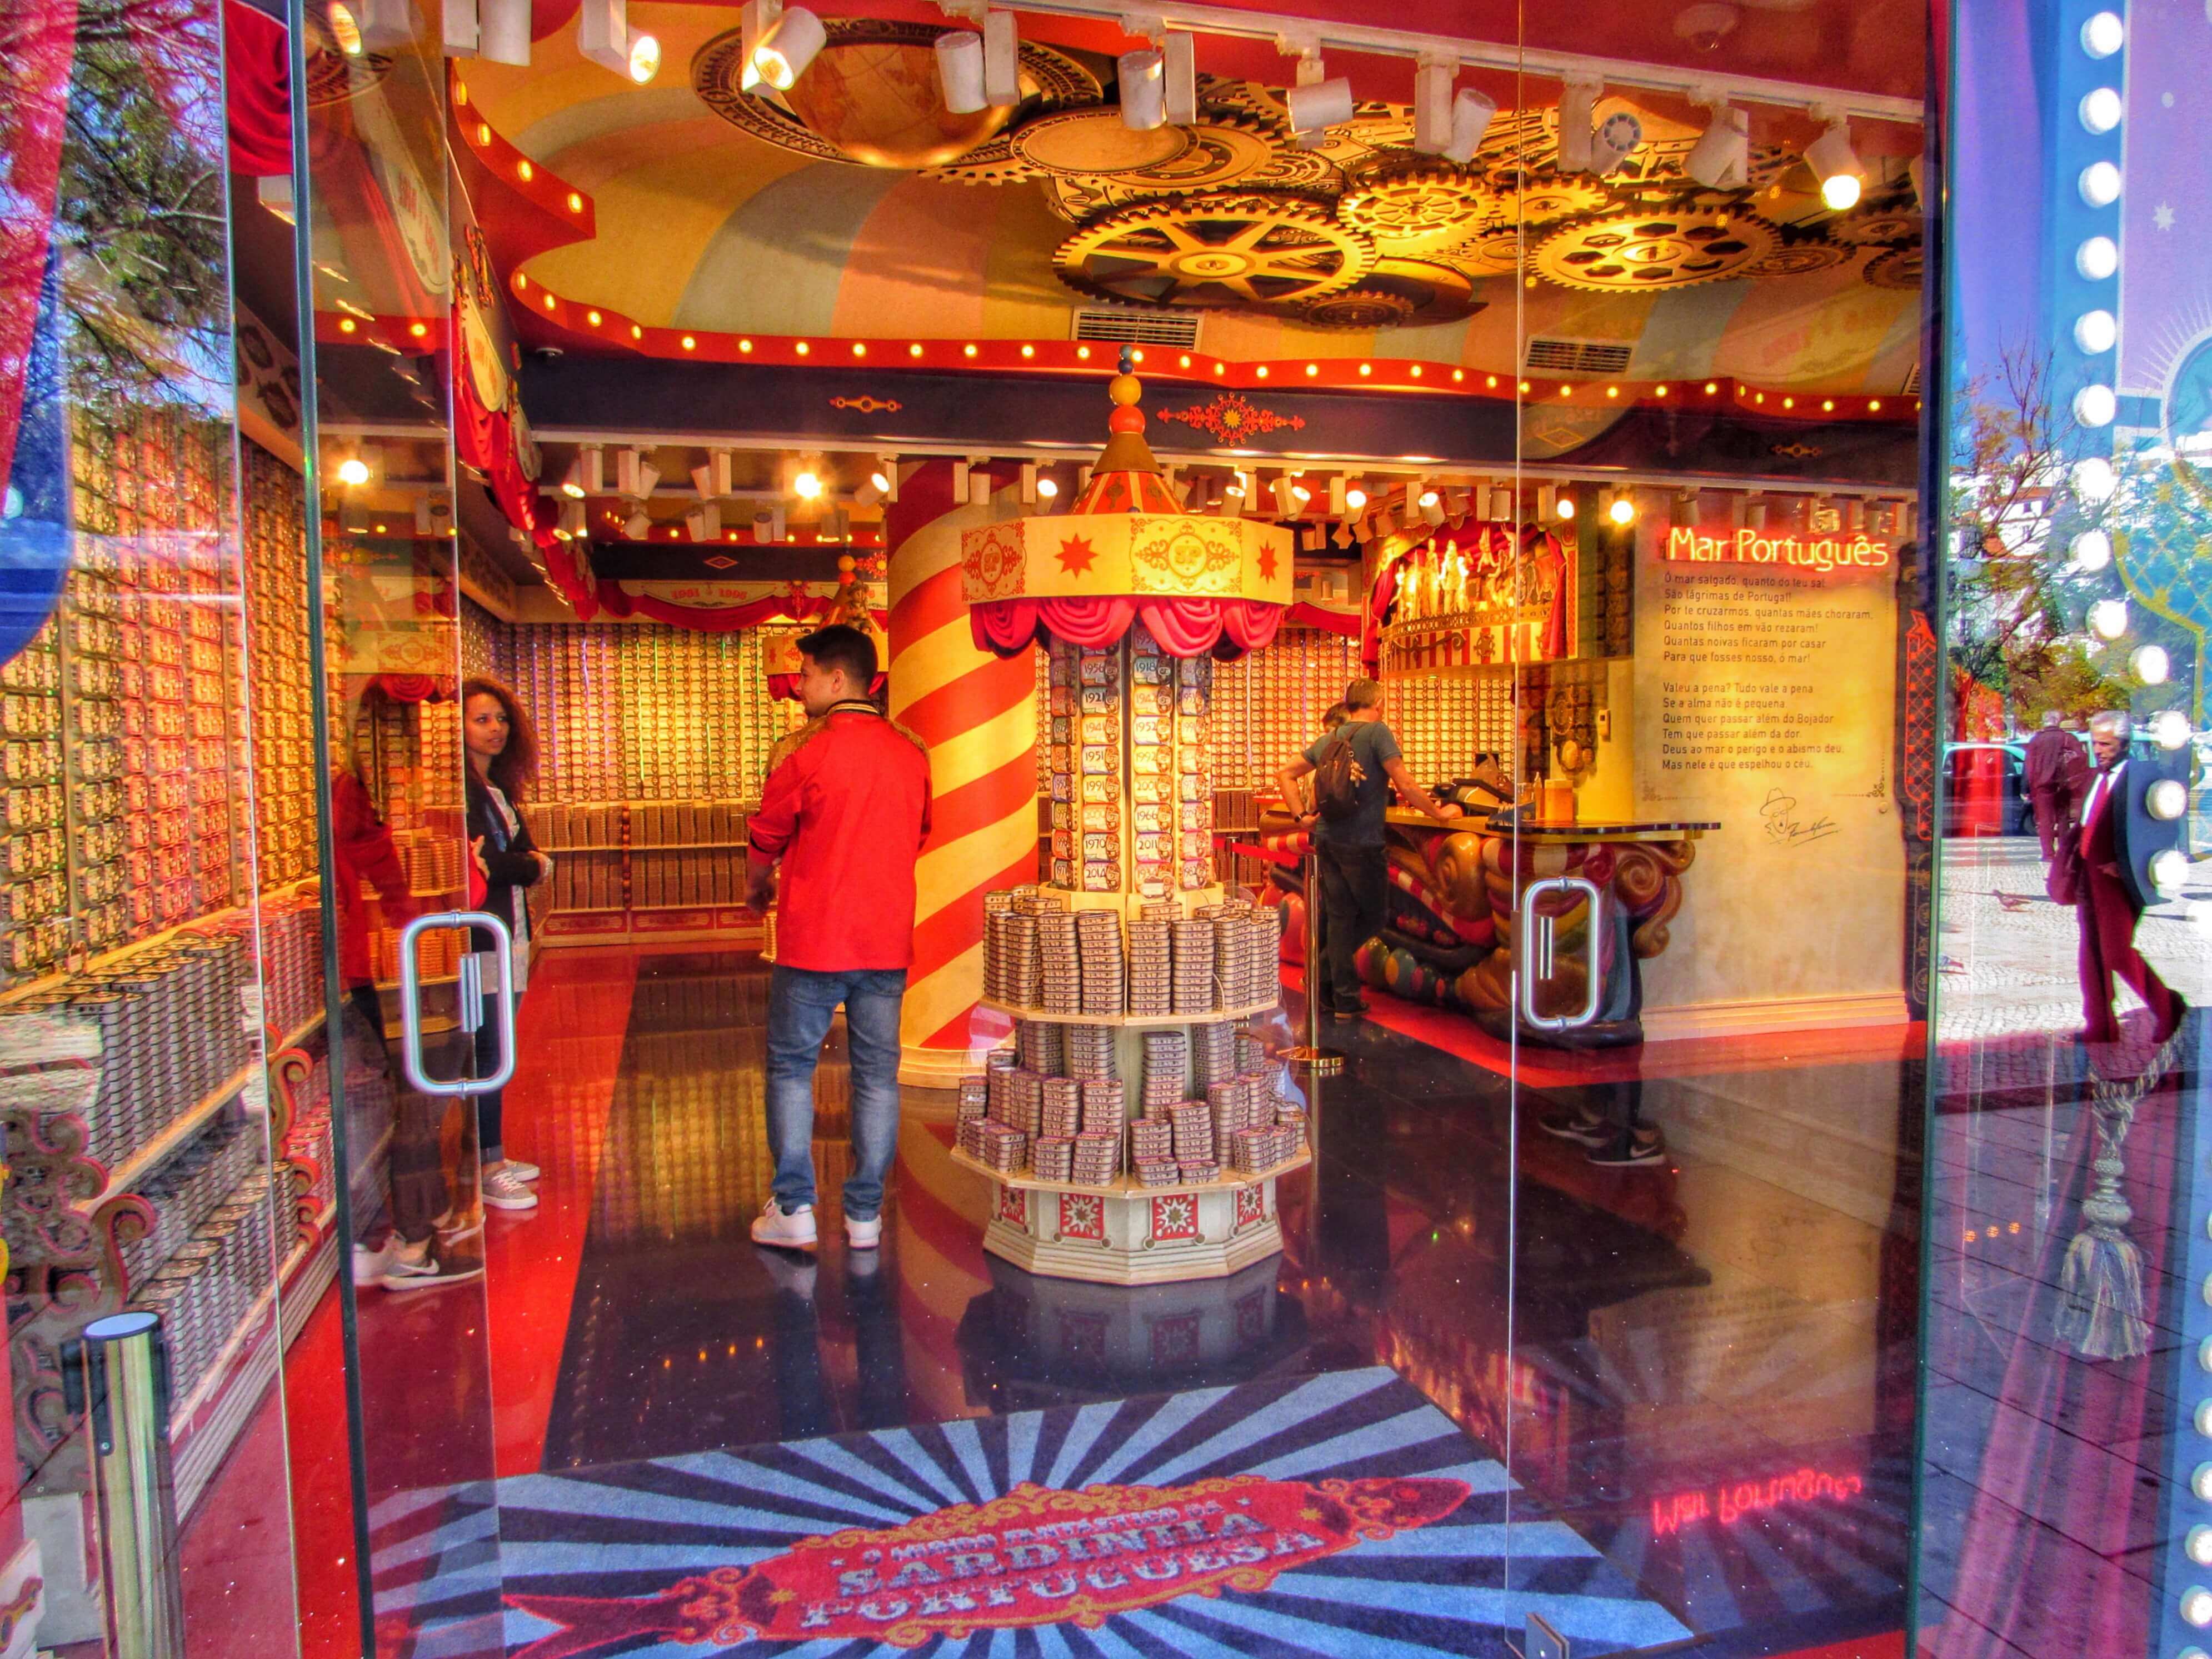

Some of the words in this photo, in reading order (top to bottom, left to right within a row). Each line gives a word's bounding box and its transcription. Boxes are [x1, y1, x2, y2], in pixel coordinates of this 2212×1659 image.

[1670, 527, 1727, 561] Mar
[1737, 529, 1889, 572] Português
[1674, 574, 1695, 584] mar
[1742, 577, 1776, 588] quanto
[1777, 577, 1790, 587] do
[1792, 577, 1808, 588] teu
[1664, 589, 1683, 599] São
[1685, 589, 1730, 602] lágrimas
[1732, 591, 1744, 601] de
[1747, 591, 1791, 603] Portugal!
[1664, 604, 1681, 615] Por
[1684, 606, 1694, 615] te
[1755, 608, 1794, 619] quantas
[1796, 608, 1822, 618] mães
[1664, 619, 1704, 631] Quantos
[1707, 621, 1735, 632] filhos
[1737, 623, 1752, 632] em
[1755, 622, 1772, 633] vão
[1775, 623, 1818, 633] rezaram!
[1664, 635, 1704, 647] Quantas
[1707, 636, 1739, 647] noivas
[1741, 637, 1778, 648] ficaram
[1781, 639, 1797, 650] por
[1800, 640, 1826, 649] casar
[1664, 651, 1686, 662] Para
[1689, 653, 1707, 664] que
[1710, 651, 1742, 662] fosses
[1779, 652, 1785, 663] ó
[1787, 653, 1810, 663] mar!
[1136, 661, 1157, 672] 1918
[1662, 682, 1690, 693] Valeu
[1693, 684, 1699, 693] a
[1702, 682, 1731, 695] pena?
[1734, 682, 1756, 693] Tudo
[1759, 683, 1779, 693] vale
[1782, 685, 1788, 693] a
[1790, 685, 1814, 696] pena
[1085, 692, 1105, 704] 1921
[1662, 697, 1676, 708] Se
[1678, 699, 1685, 708] a
[1687, 698, 1712, 708] alma
[1715, 698, 1732, 708] não
[1735, 697, 1741, 708] é
[1662, 713, 1691, 724] Quem
[1695, 715, 1717, 726] quer
[1720, 715, 1754, 726] passar
[1756, 713, 1780, 724] além
[1782, 713, 1795, 724] do
[1796, 713, 1834, 726] Bojador
[1662, 728, 1683, 739] Tem
[1686, 731, 1704, 741] que
[1706, 731, 1740, 741] passar
[1742, 728, 1767, 738] além
[1770, 728, 1781, 738] da
[1085, 750, 1104, 762] 1951
[1662, 743, 1687, 754] Deus
[1690, 746, 1702, 754] ao
[1705, 746, 1725, 754] mar
[1736, 746, 1767, 756] perigo
[1770, 746, 1776, 754] e
[1778, 745, 1784, 753] o
[1786, 743, 1821, 754] abismo
[1662, 759, 1682, 770] Mas
[1709, 759, 1715, 769] é
[1717, 761, 1736, 772] que
[1738, 758, 1782, 771] espelhou
[1785, 761, 1791, 769] o
[1137, 809, 1158, 821] 1966
[1085, 838, 1106, 849] 1970
[1139, 839, 1157, 850] 2011
[1086, 868, 1106, 878] 2014
[838, 1513, 1272, 1598] SARDINHA
[800, 1529, 1326, 1628] PORTUGUESA
